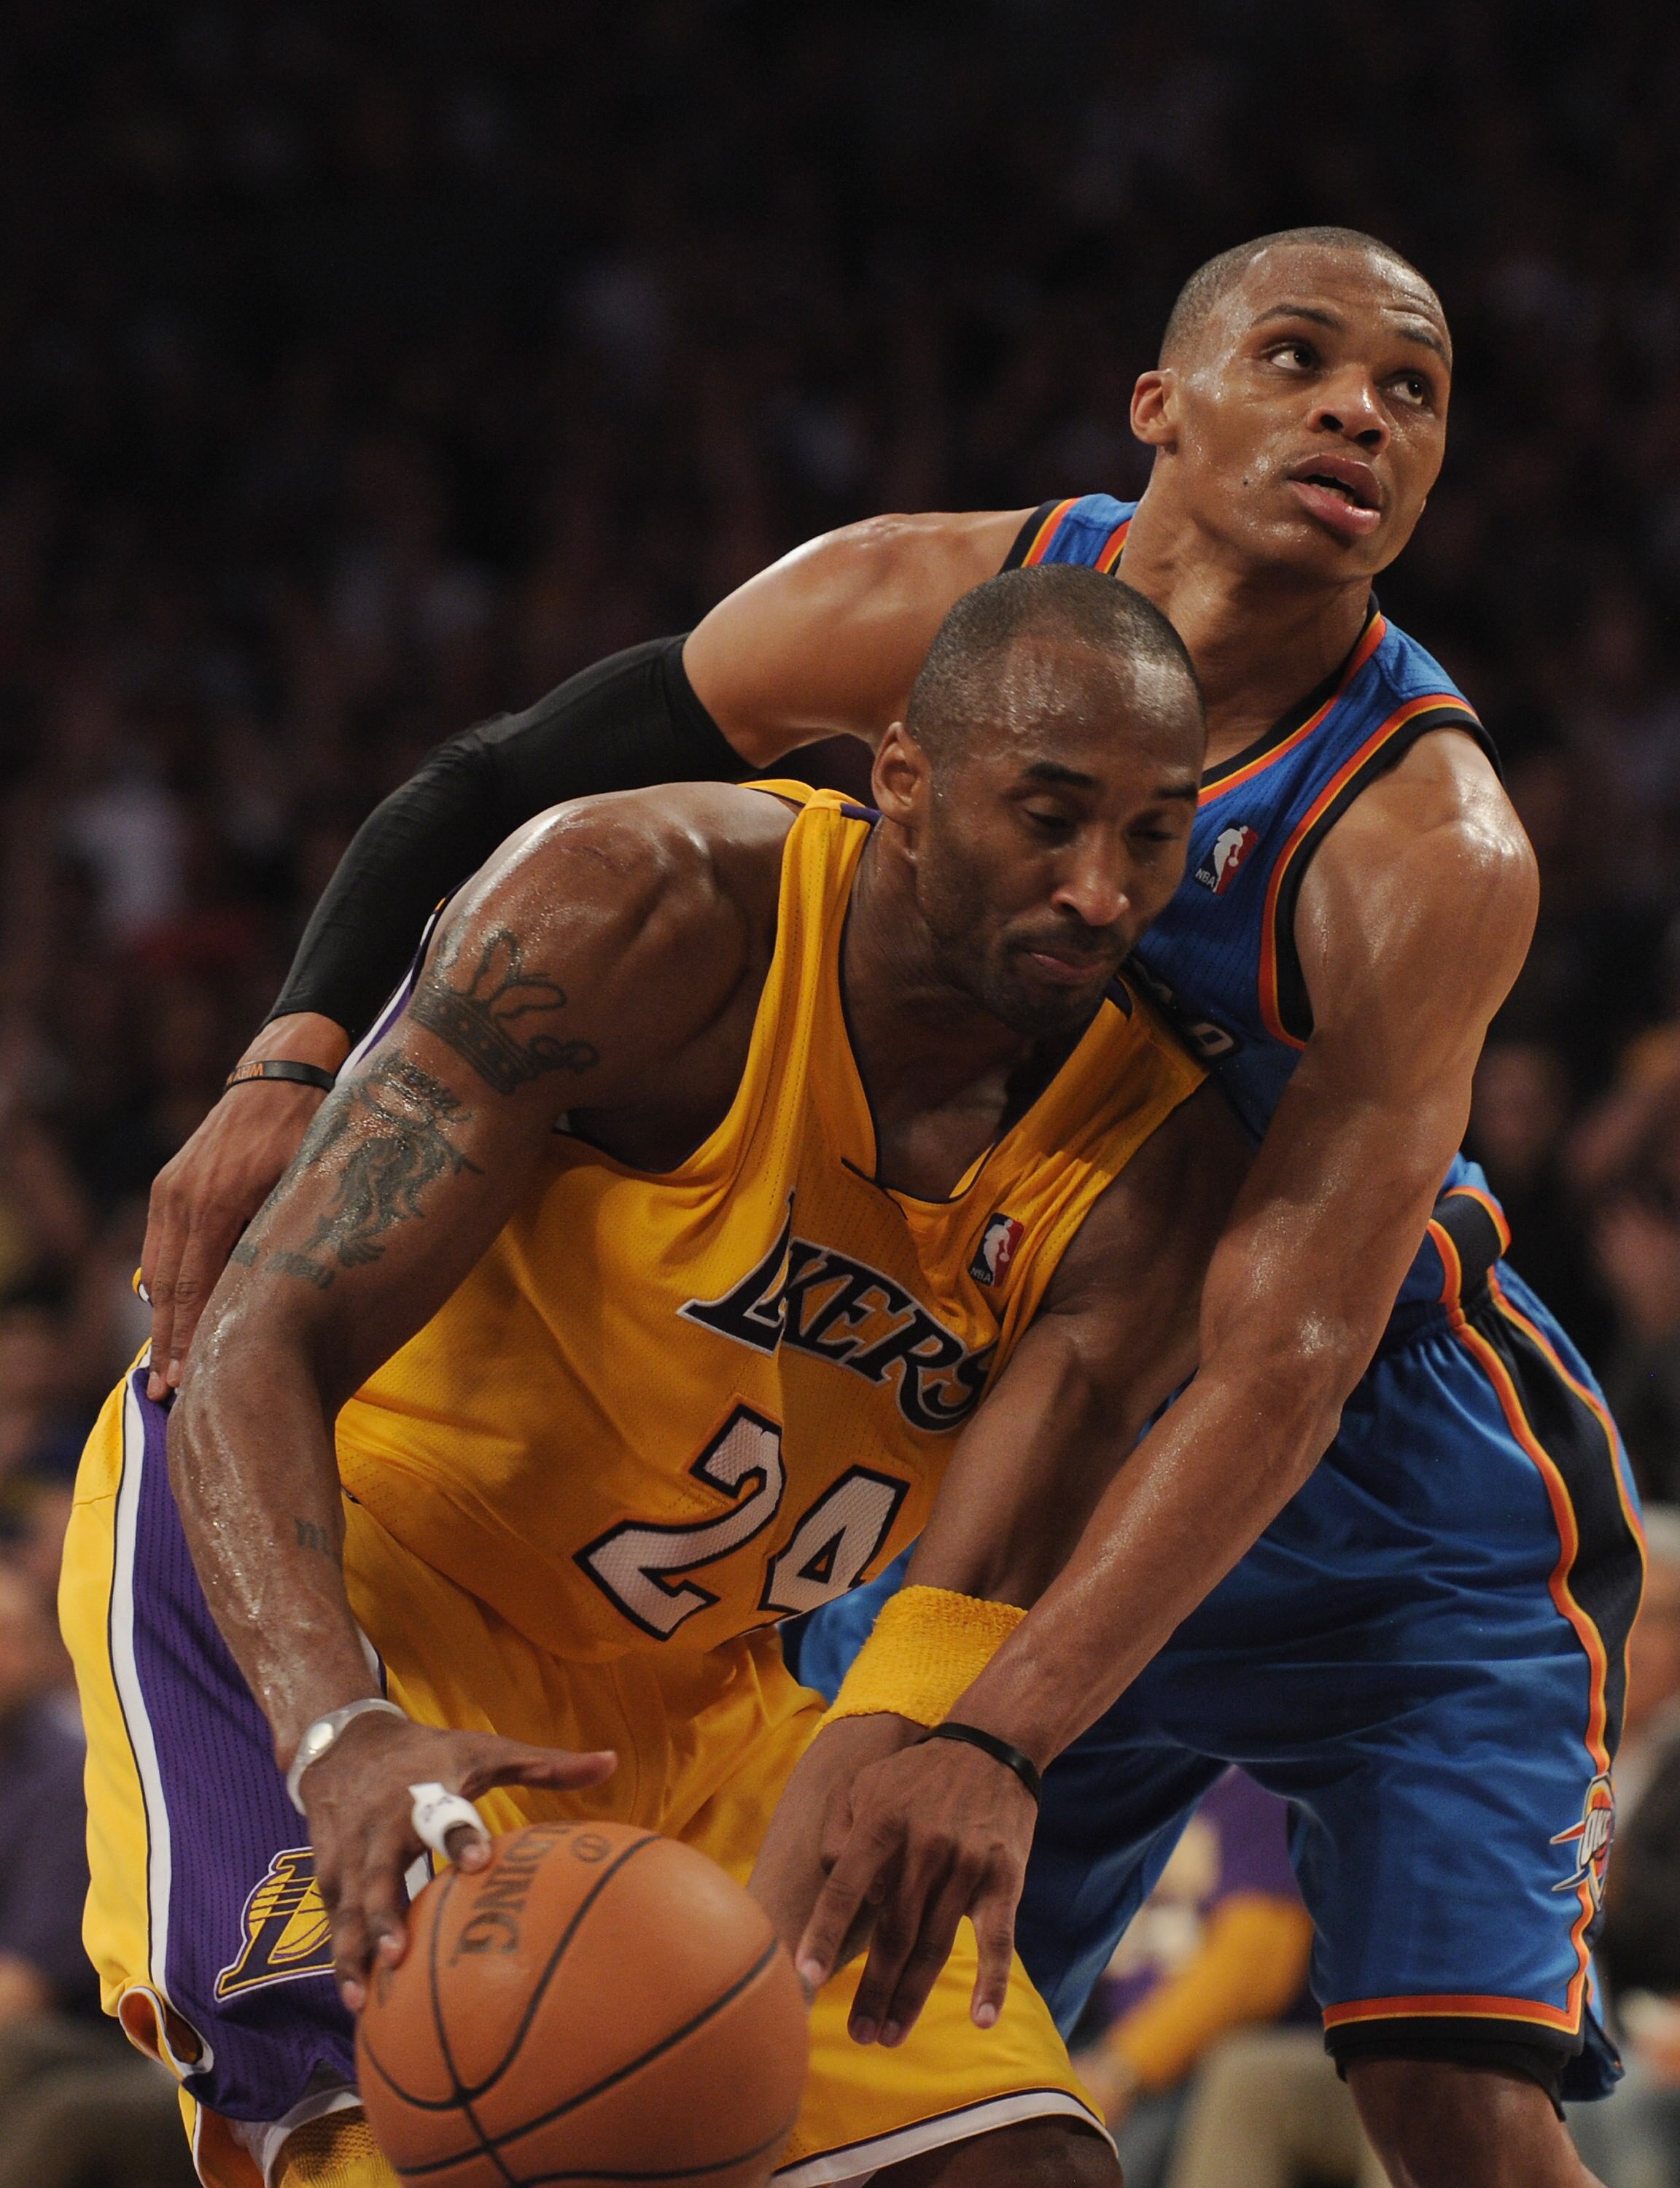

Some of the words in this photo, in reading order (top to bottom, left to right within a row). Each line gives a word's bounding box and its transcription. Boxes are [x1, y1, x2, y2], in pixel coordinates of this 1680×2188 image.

[1194, 867, 1216, 888] NBA
[677, 1186, 1000, 1434] LKERS
[970, 1267, 992, 1284] NBA
[572, 1403, 911, 1641] 24
